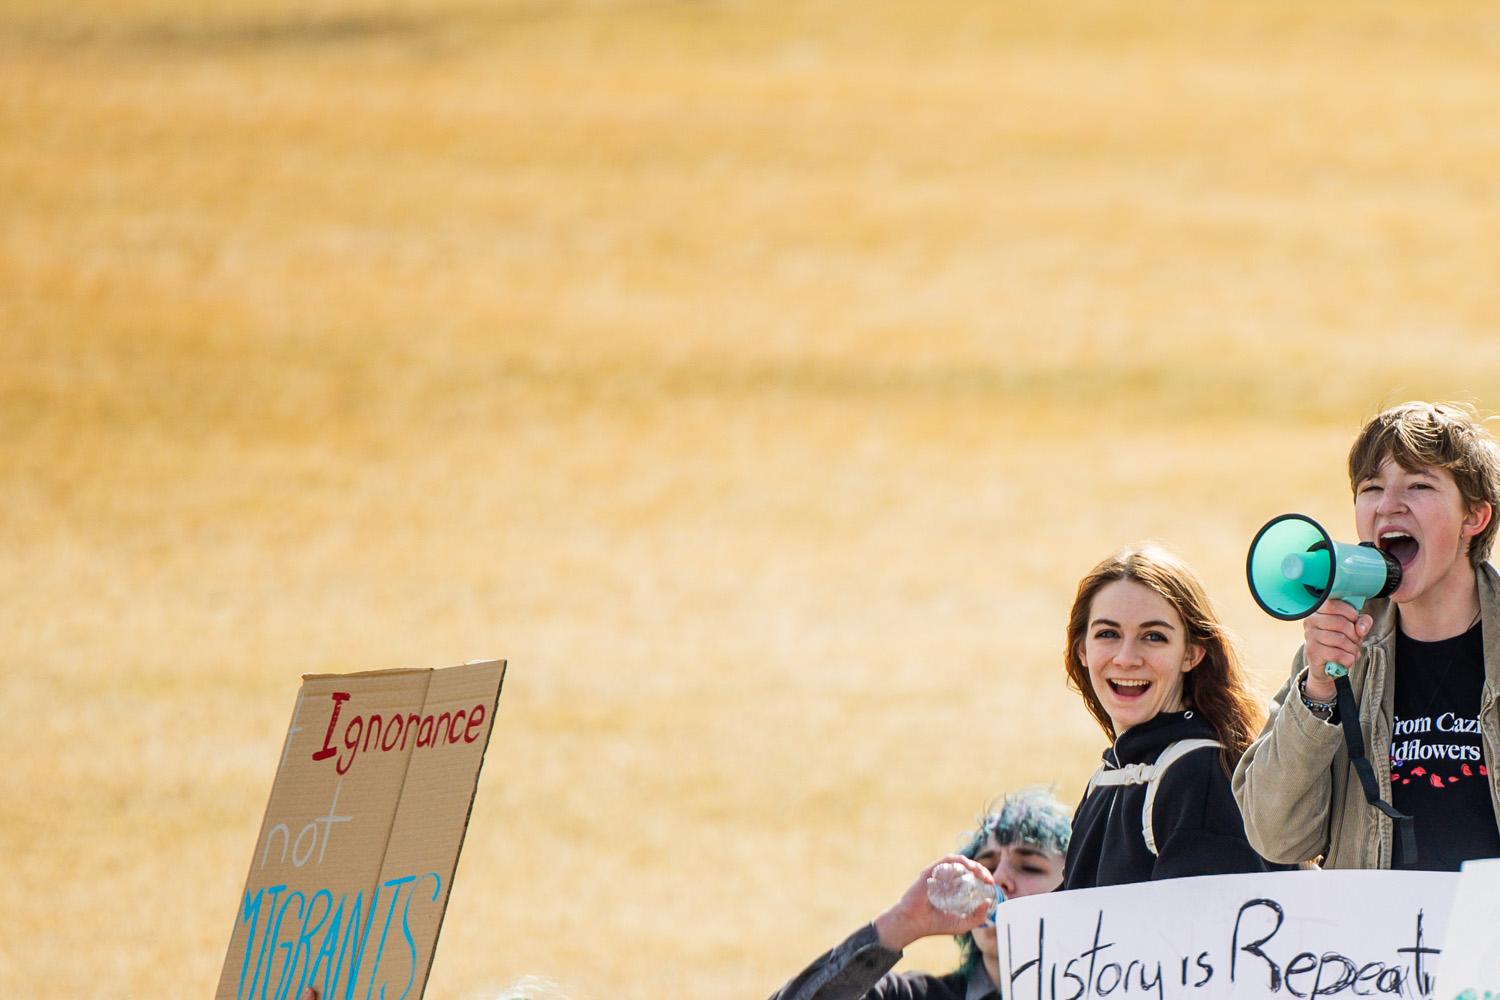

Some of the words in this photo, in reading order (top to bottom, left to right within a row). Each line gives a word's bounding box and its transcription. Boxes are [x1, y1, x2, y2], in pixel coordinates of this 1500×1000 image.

[312, 692, 486, 775] Ignorance
[1393, 716, 1432, 736] rom
[260, 782, 354, 868] not
